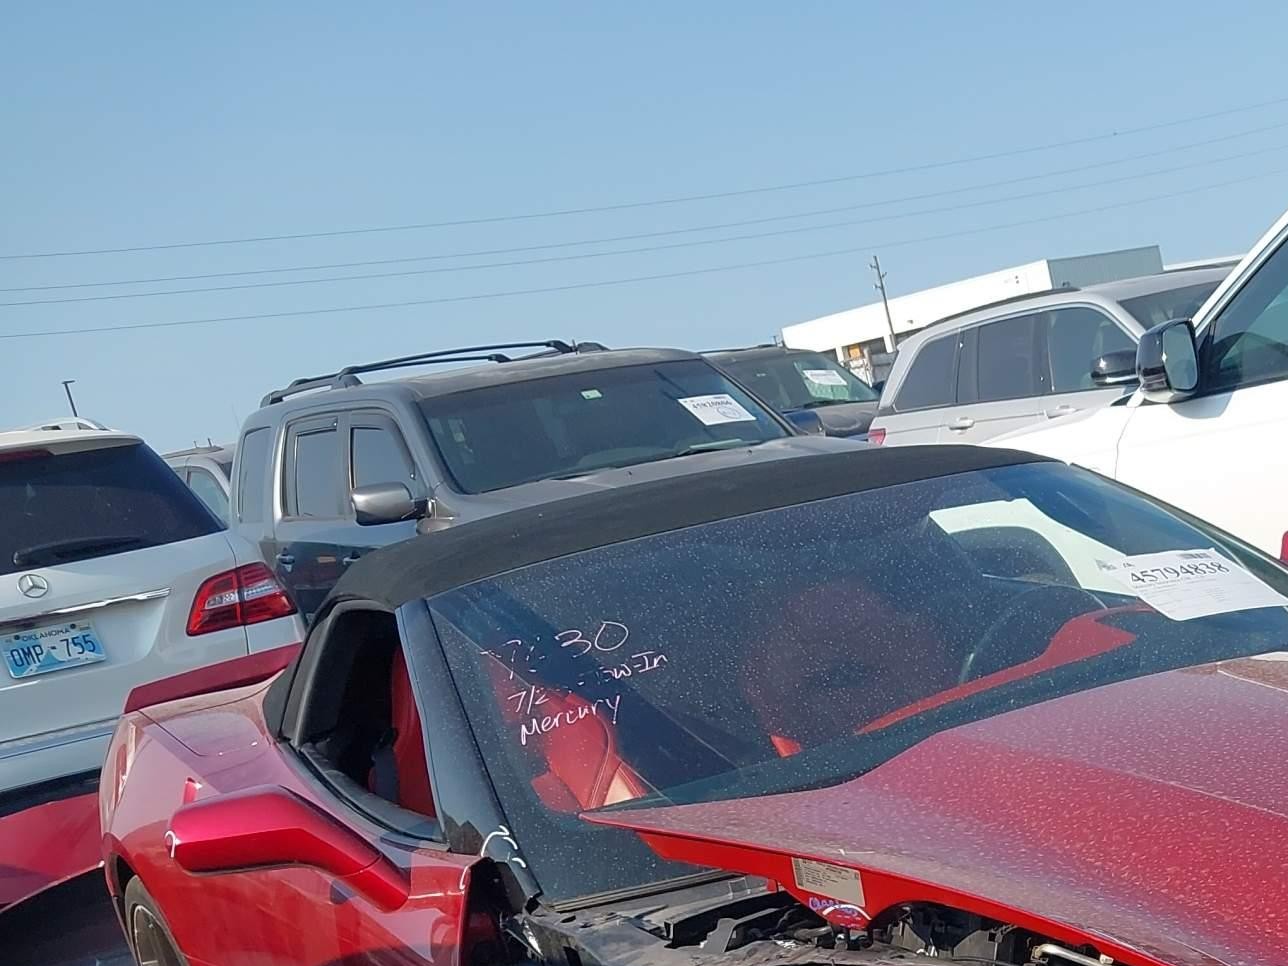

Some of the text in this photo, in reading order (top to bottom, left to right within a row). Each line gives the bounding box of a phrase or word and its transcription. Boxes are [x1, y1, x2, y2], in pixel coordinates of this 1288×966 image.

[1131, 561, 1230, 584] 45794838
[22, 628, 70, 642] OKLAHOMA
[520, 695, 621, 745] Mercury
